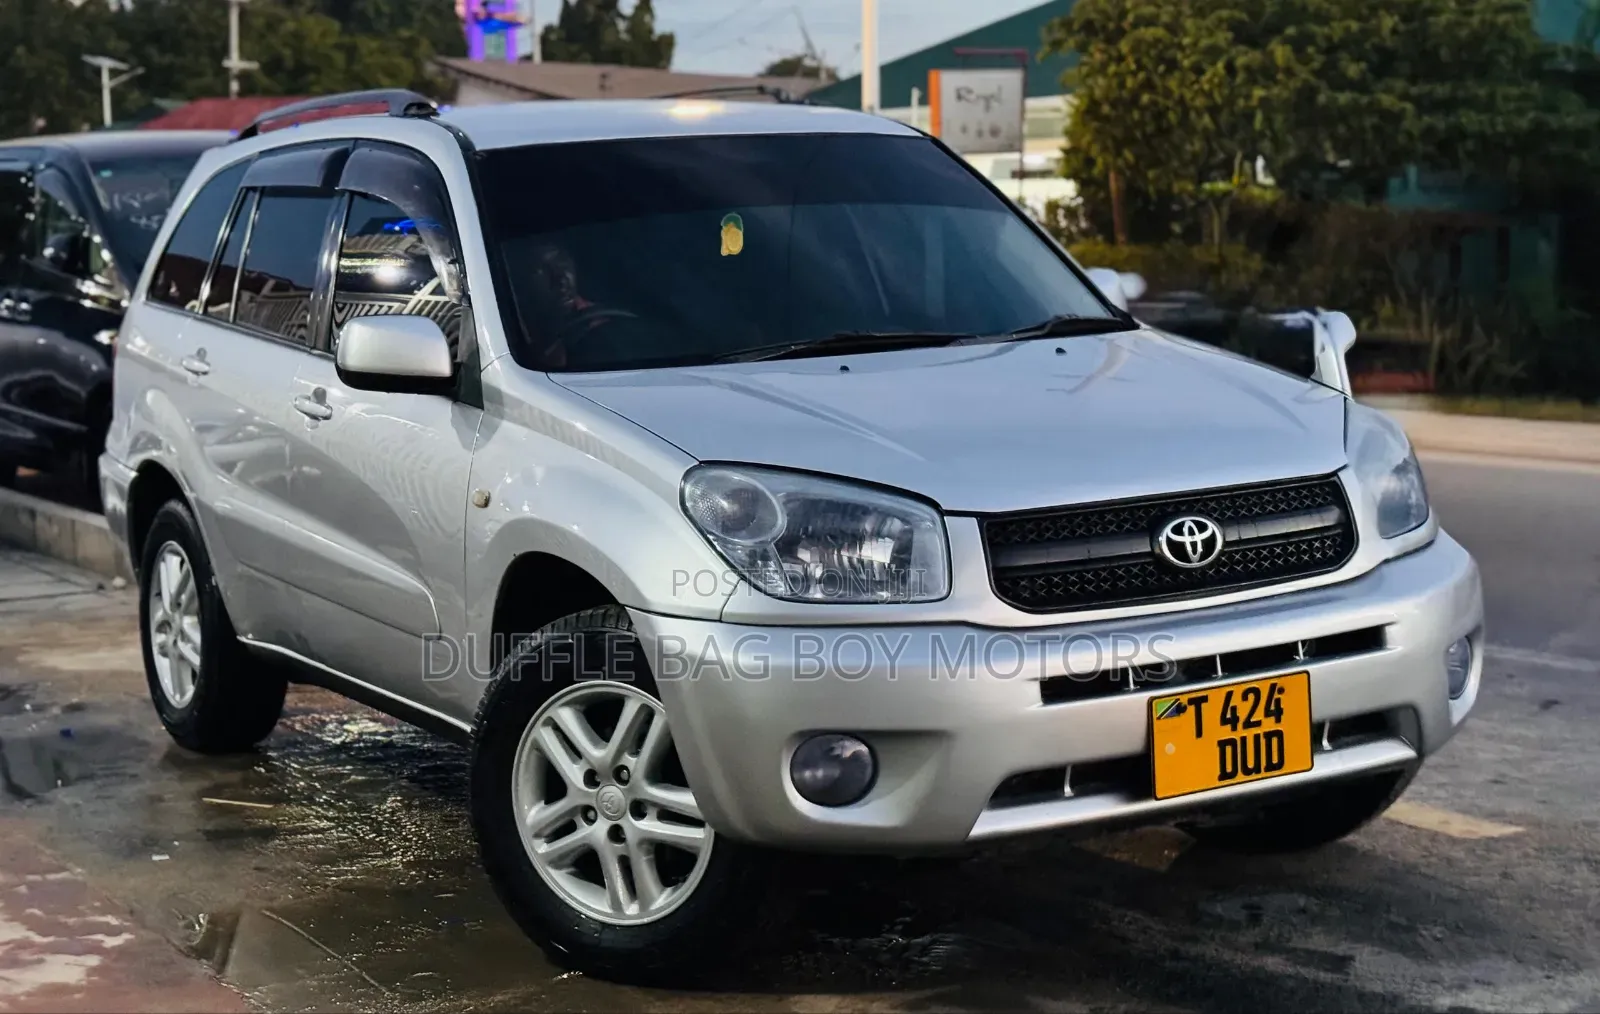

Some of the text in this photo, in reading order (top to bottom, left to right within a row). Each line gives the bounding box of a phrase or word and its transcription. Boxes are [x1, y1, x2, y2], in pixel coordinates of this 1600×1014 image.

[1187, 682, 1285, 740] T 424
[1216, 728, 1285, 782] DUD
